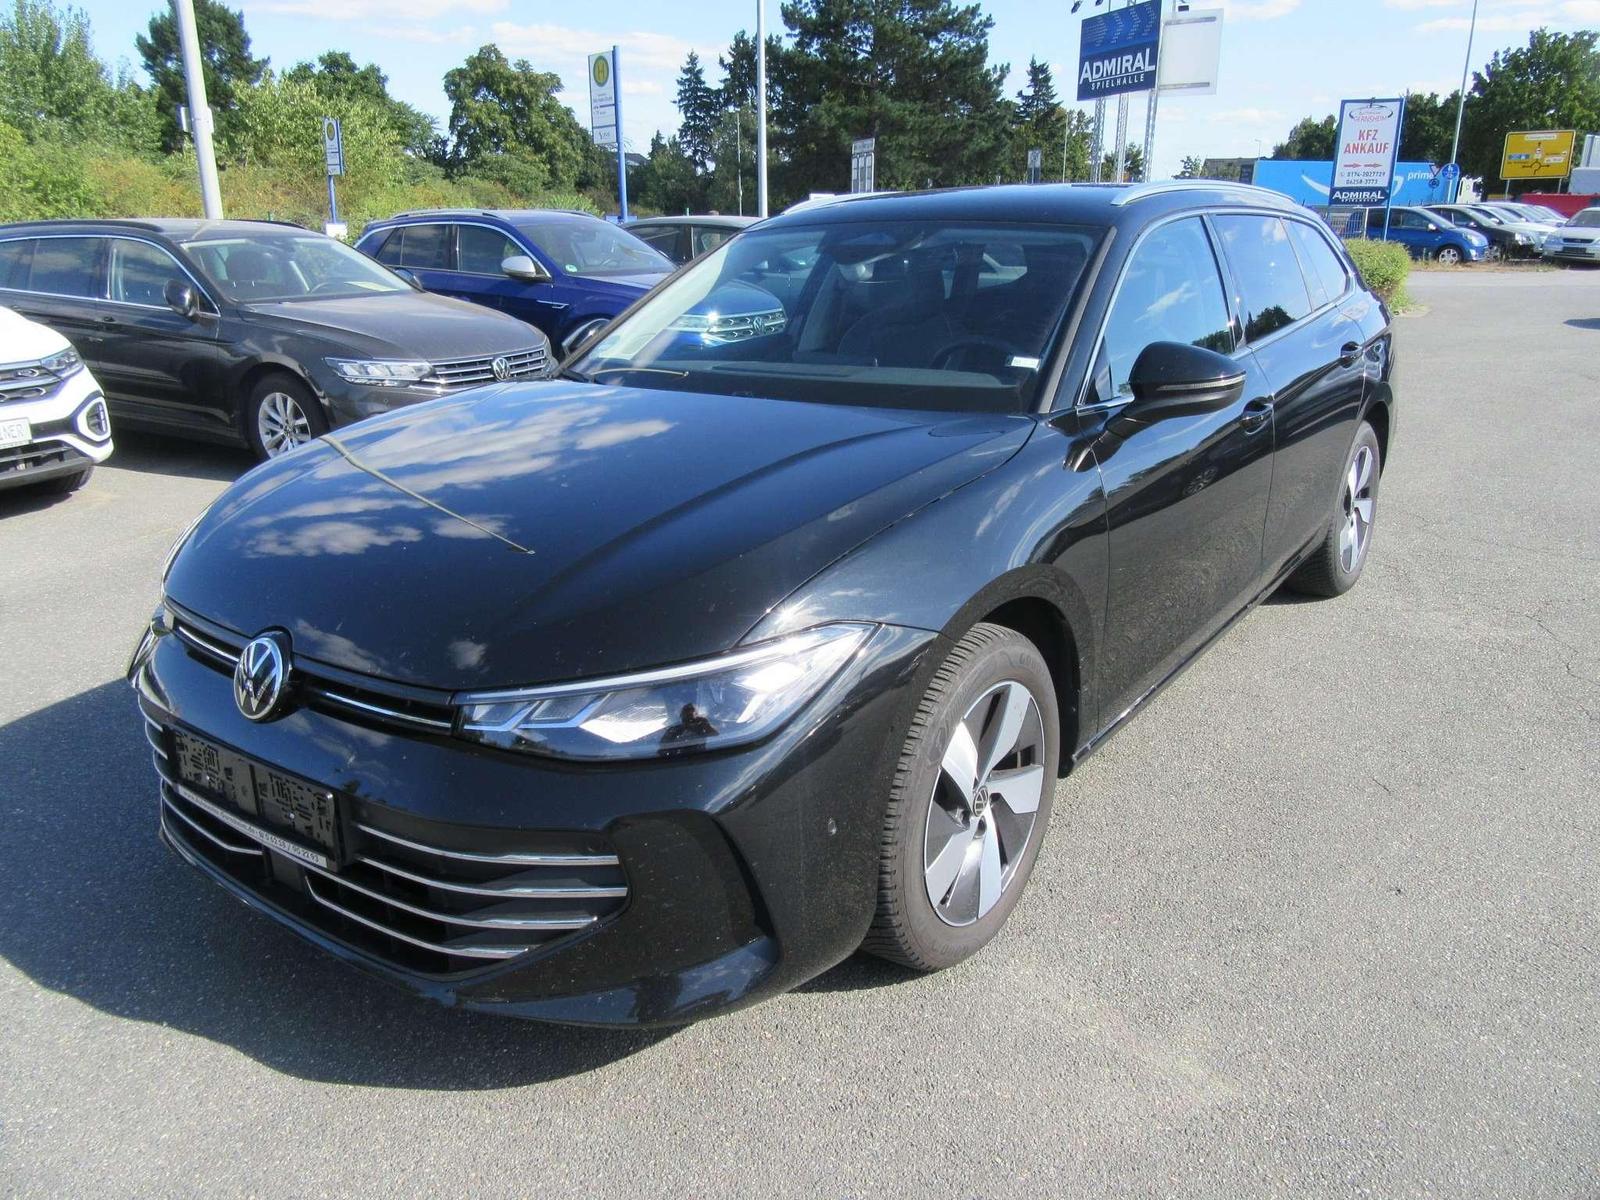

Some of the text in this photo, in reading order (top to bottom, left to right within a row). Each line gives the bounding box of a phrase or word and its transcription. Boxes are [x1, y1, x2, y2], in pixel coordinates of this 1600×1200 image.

[1079, 48, 1156, 84] ADMIRAL
[1091, 73, 1145, 90] SPIELHALLE
[1358, 129, 1379, 141] KFZ
[1343, 142, 1390, 154] ANKAUF
[1332, 190, 1385, 200] ADMIRAL
